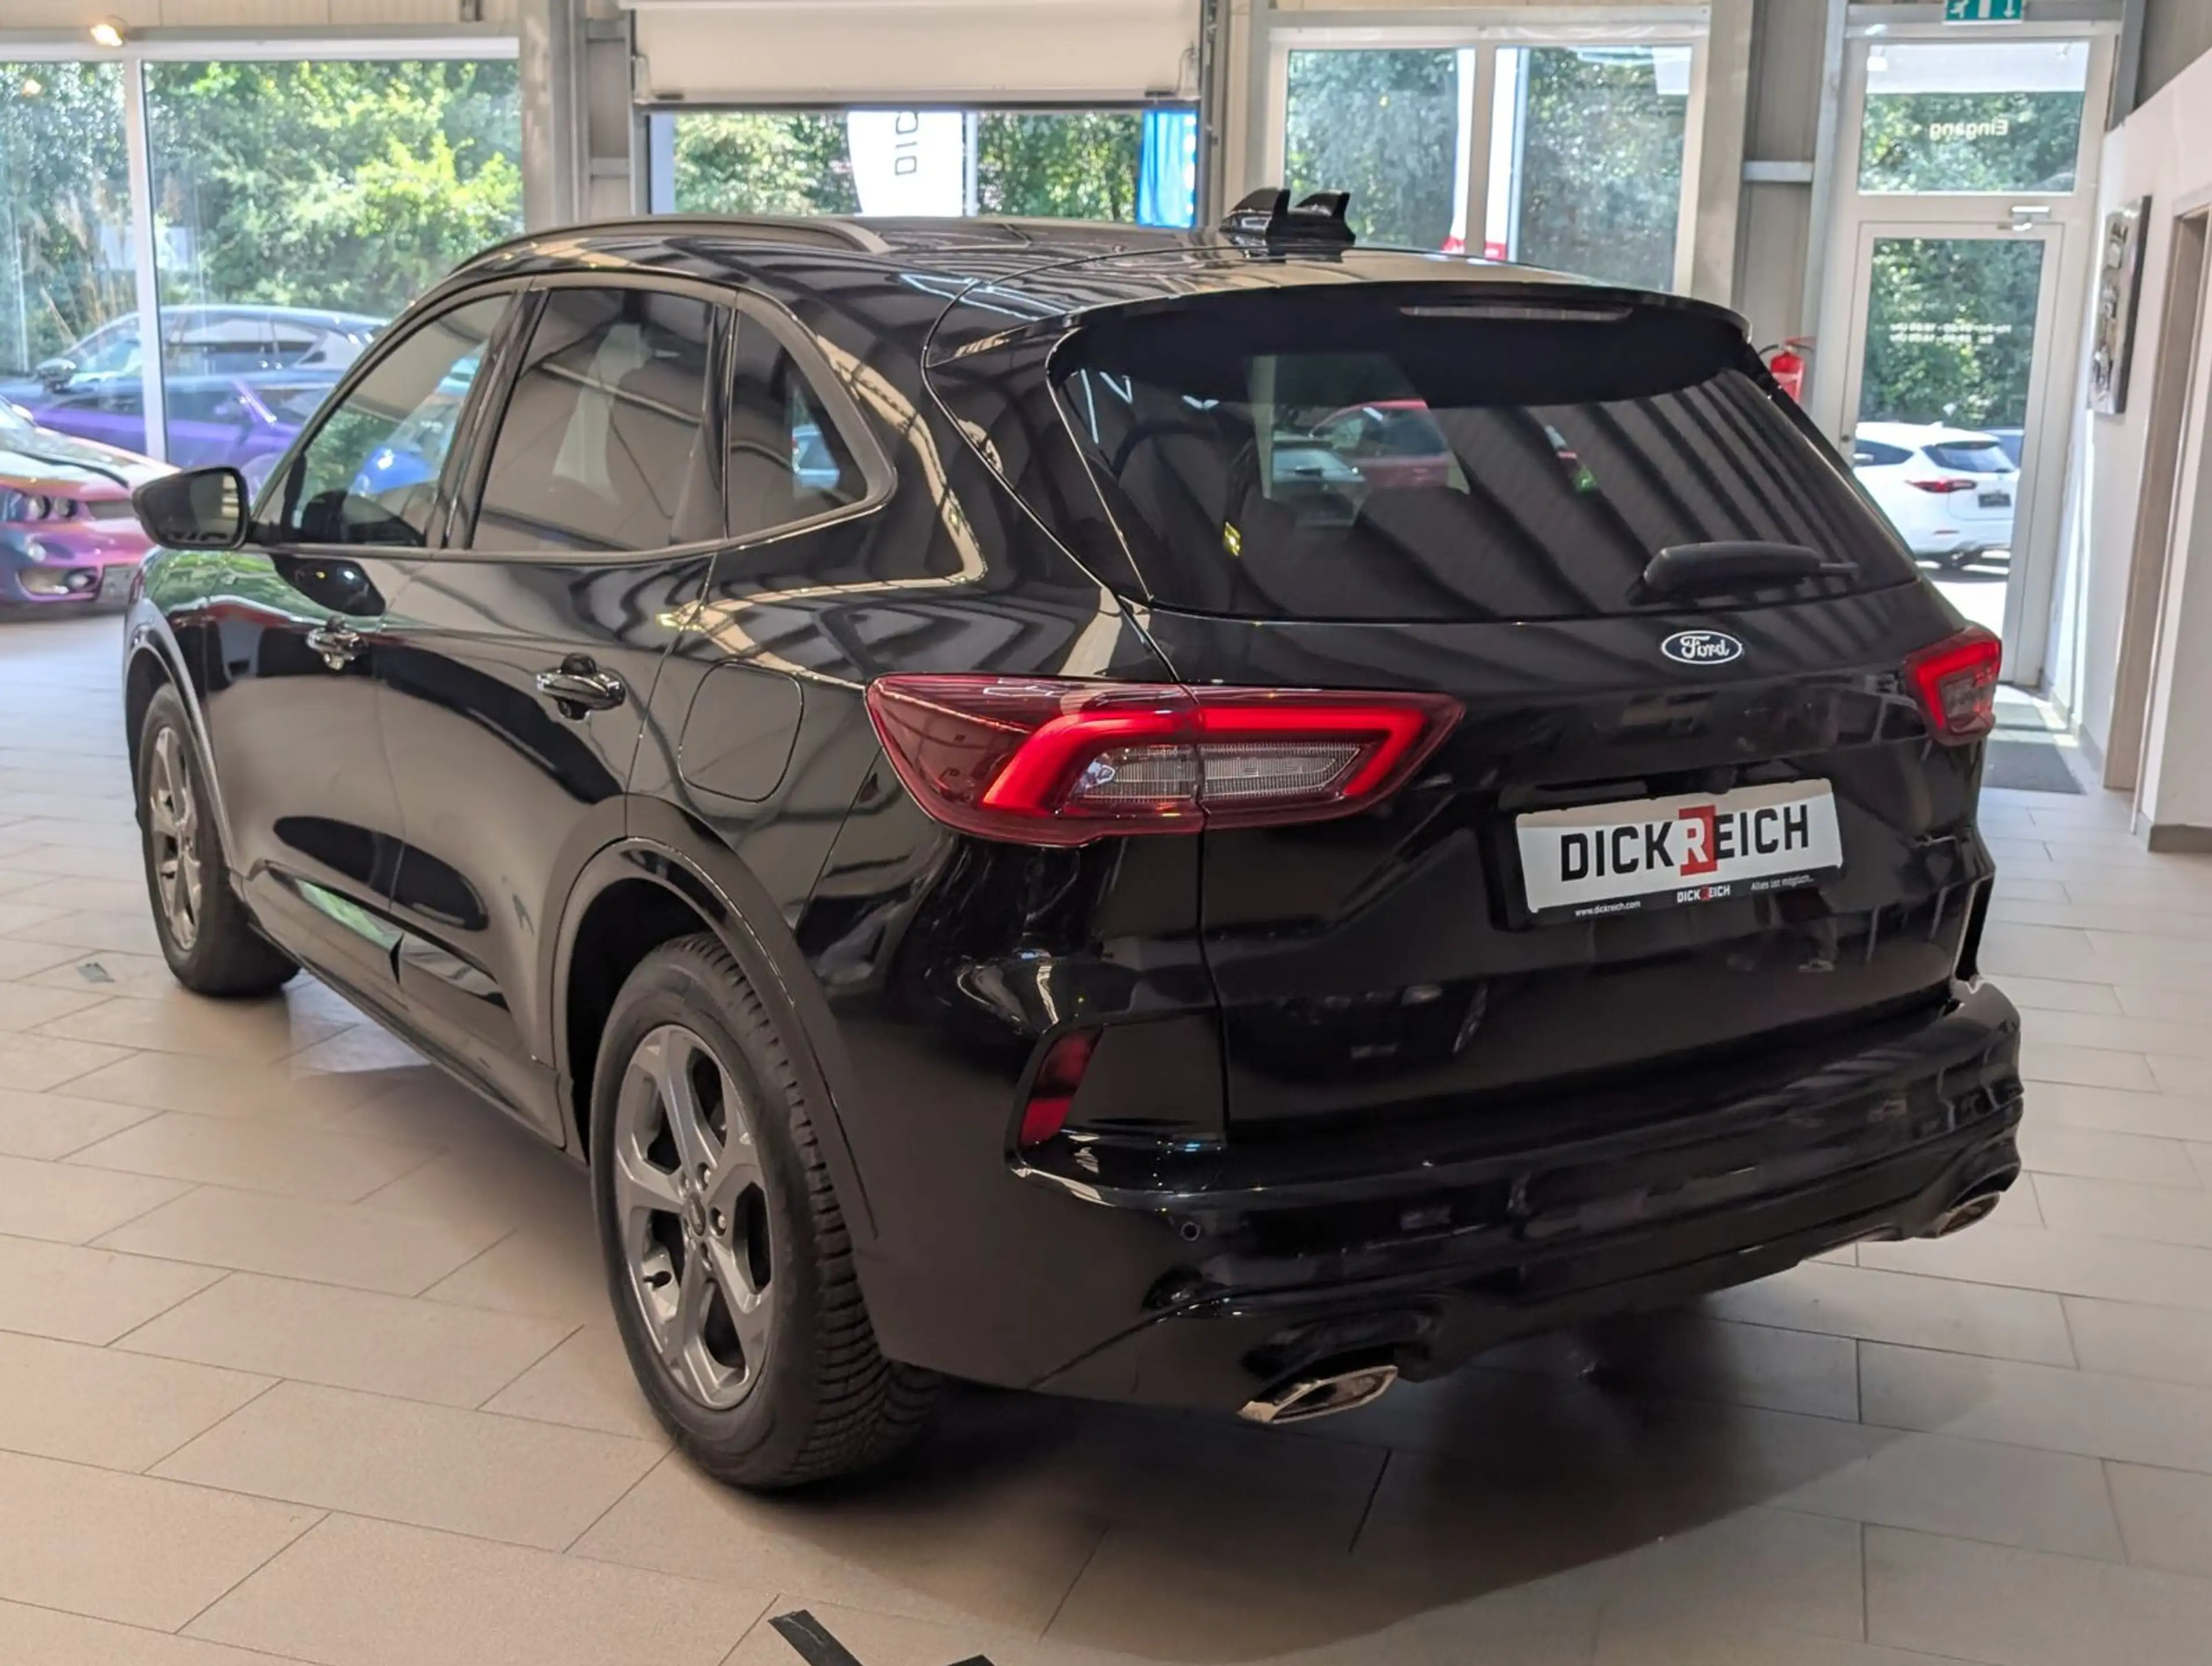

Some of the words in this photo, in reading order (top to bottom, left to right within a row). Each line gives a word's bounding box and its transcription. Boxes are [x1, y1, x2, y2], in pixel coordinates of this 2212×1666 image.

[1680, 636, 1729, 659] Ford
[1561, 805, 1809, 882] DICKREICH
[1575, 901, 1641, 917] www.dickreich.com
